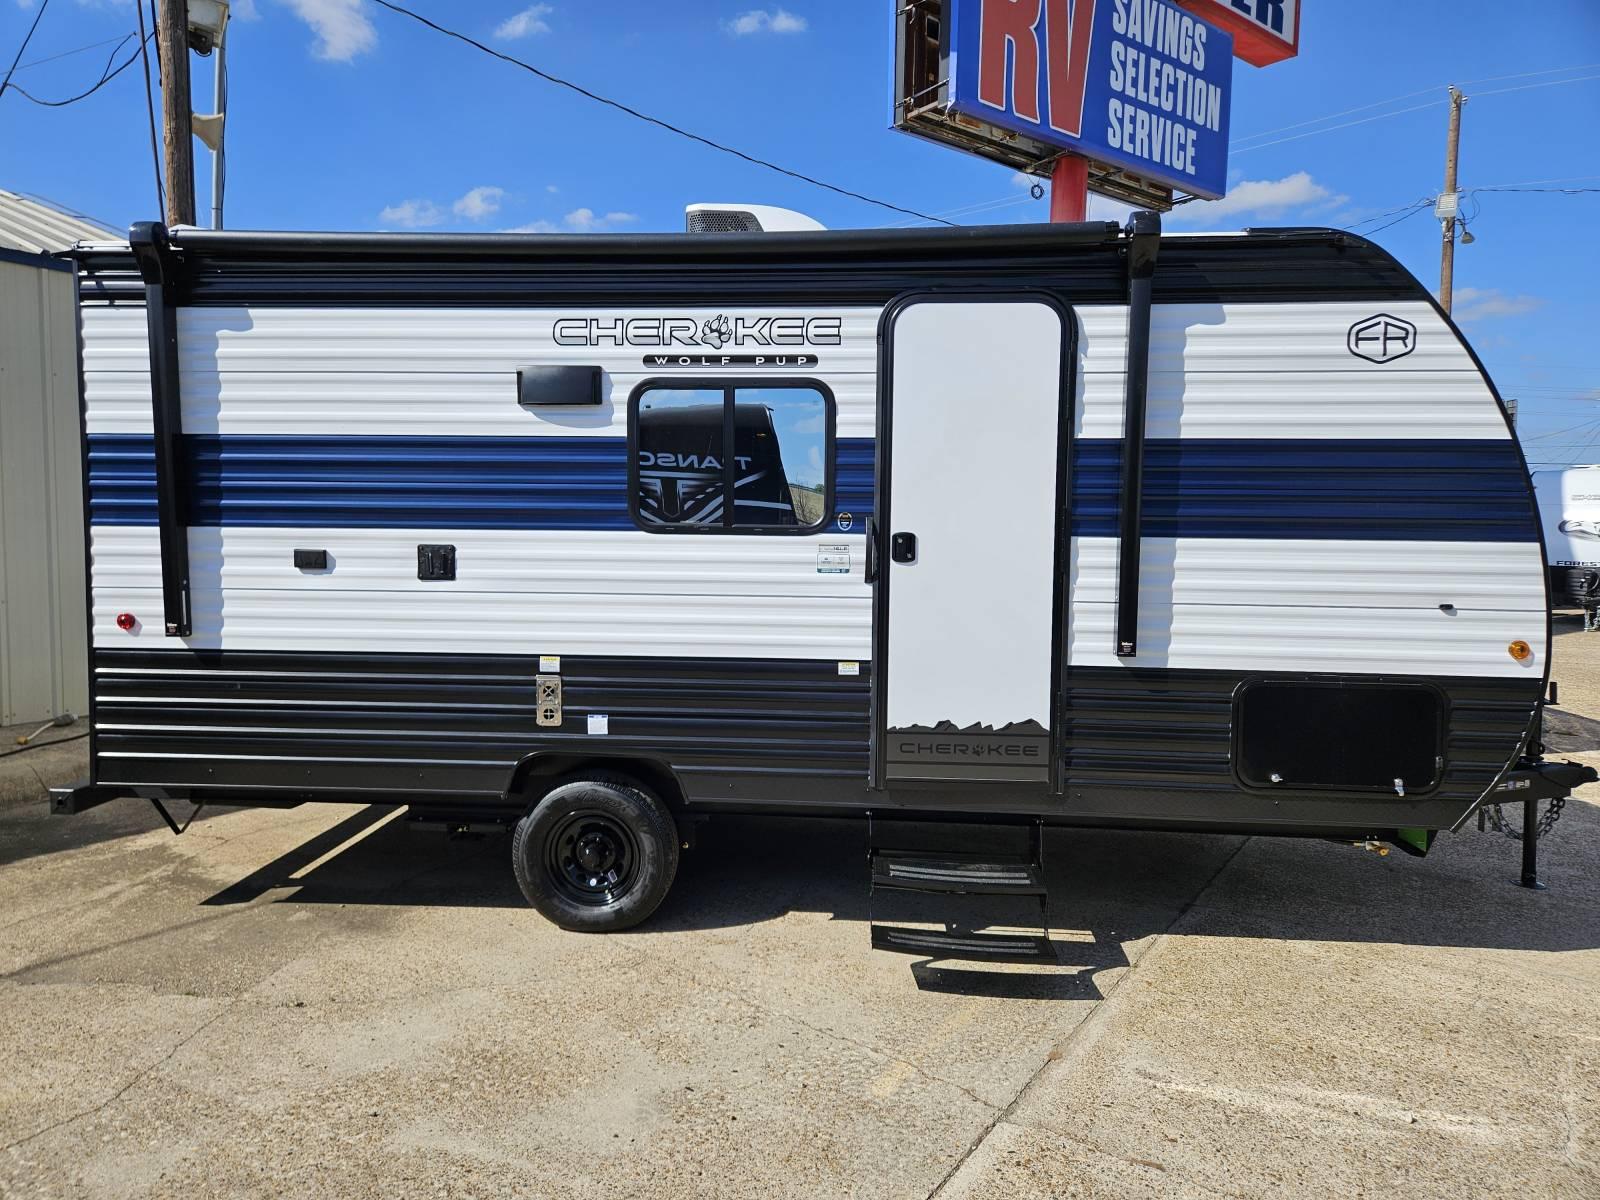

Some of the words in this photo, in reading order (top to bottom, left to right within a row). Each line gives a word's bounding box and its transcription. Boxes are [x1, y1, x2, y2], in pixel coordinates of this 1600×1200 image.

[977, 0, 1097, 139] RV
[1112, 0, 1207, 72] SAVINGS
[1109, 40, 1222, 133] SELECTION
[1107, 98, 1197, 176] SERVICE
[654, 356, 731, 366] WOLF
[755, 356, 807, 366] PUP
